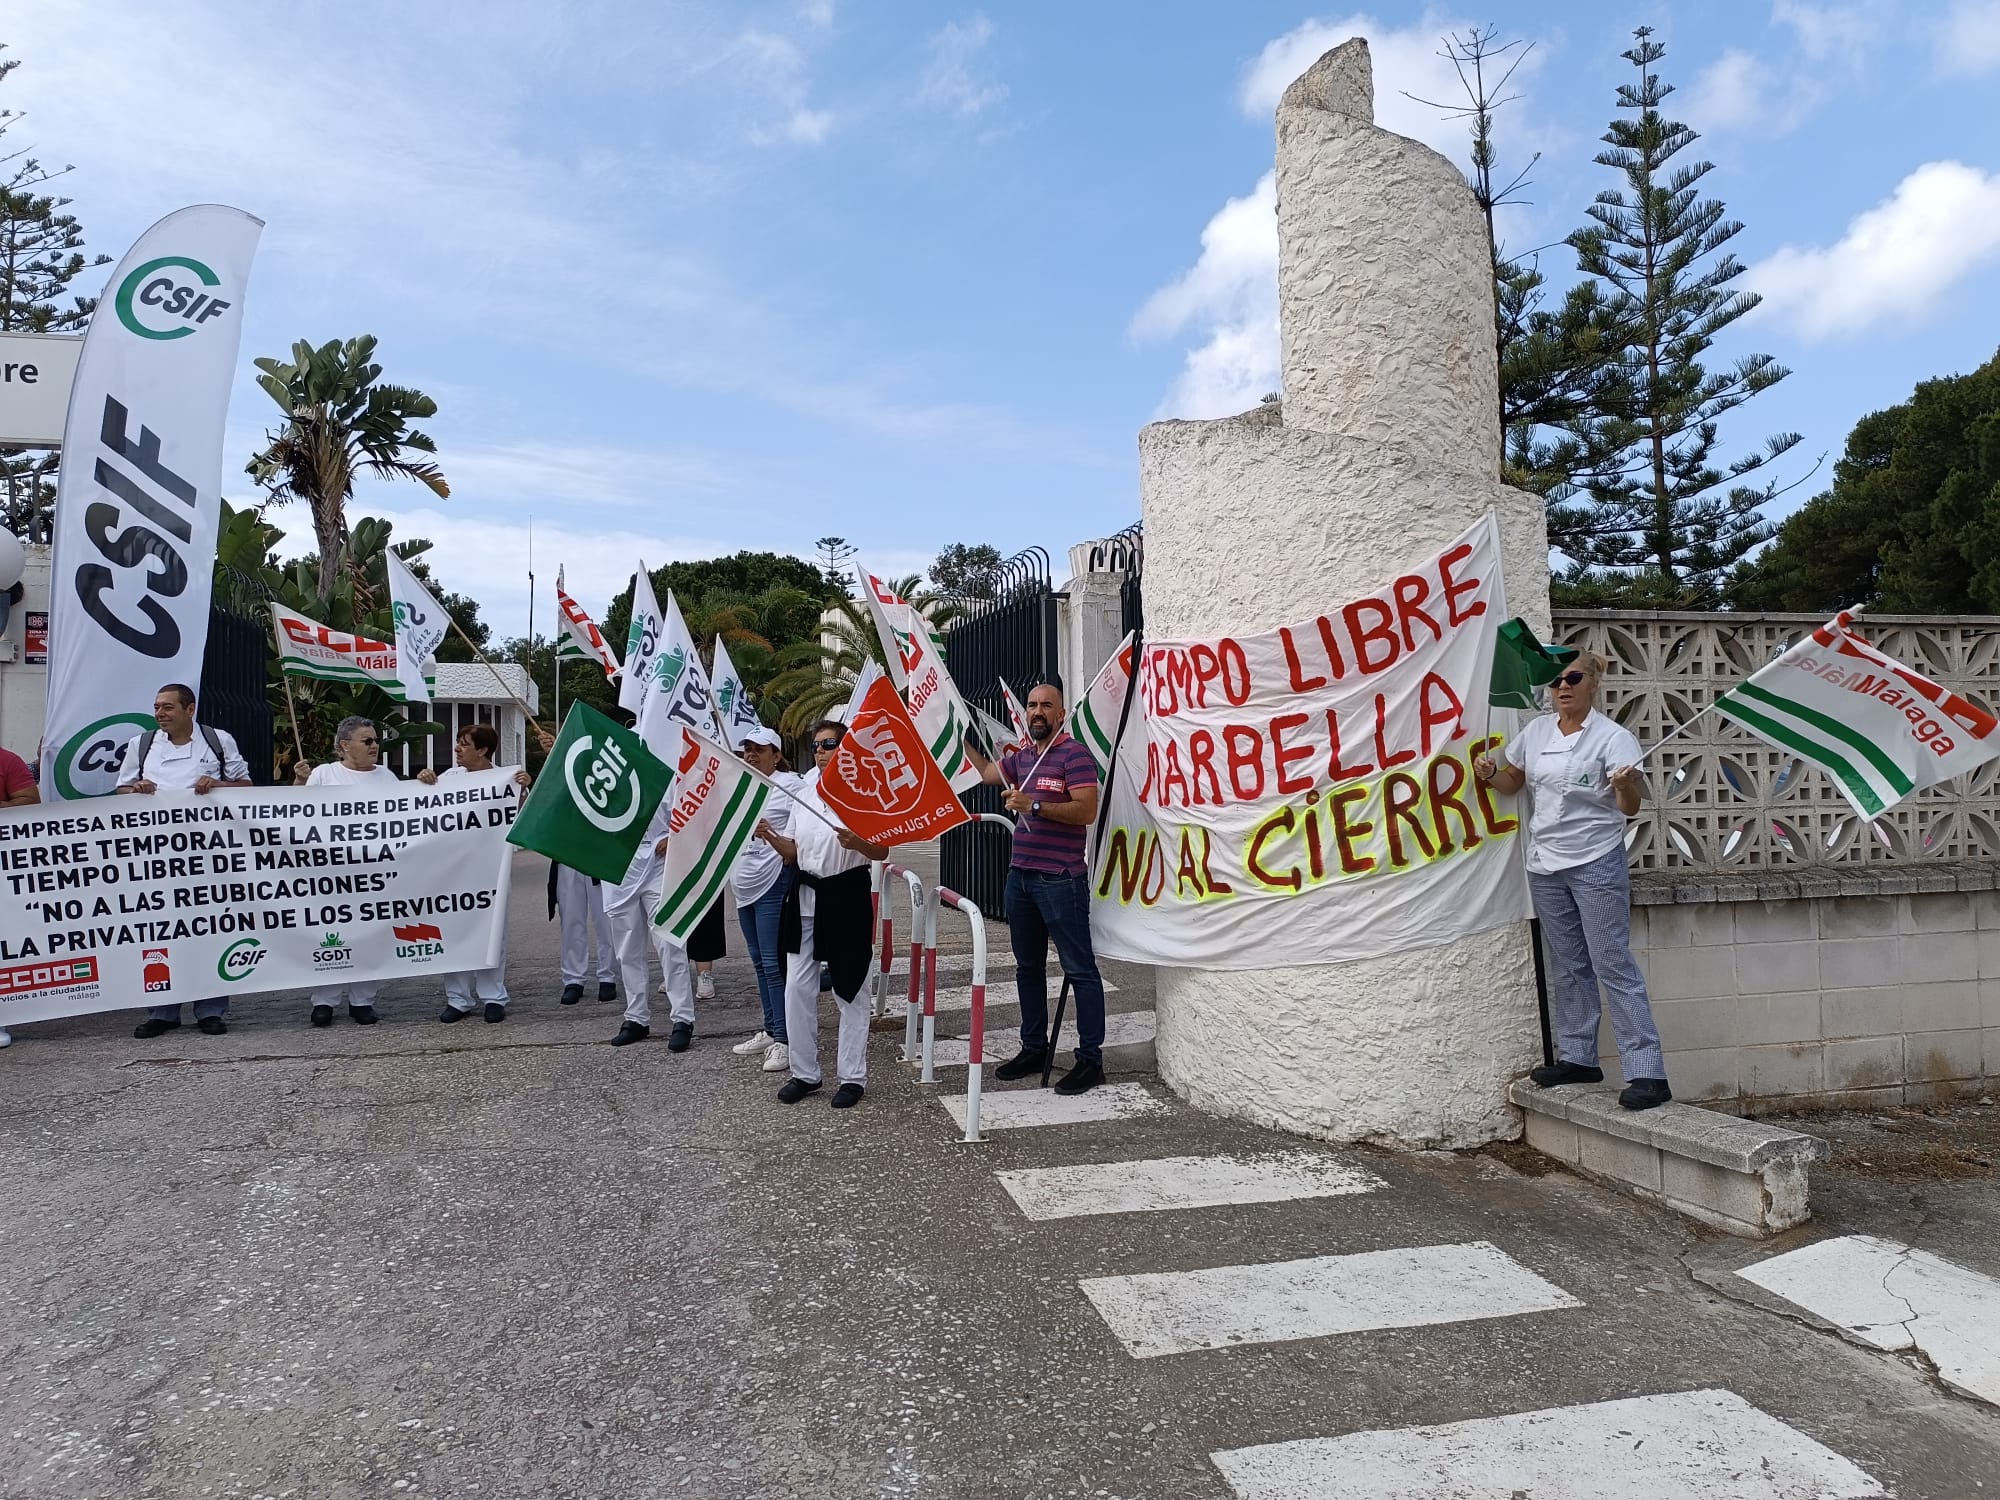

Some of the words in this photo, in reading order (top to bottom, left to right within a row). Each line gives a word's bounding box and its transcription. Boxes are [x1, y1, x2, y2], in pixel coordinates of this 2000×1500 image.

[140, 278, 230, 324] CSIF
[0, 364, 39, 384] re
[75, 394, 197, 658] CSIF
[1280, 544, 1486, 692] LIBRE
[356, 655, 397, 670] Mála
[1854, 674, 1955, 757] Málaga
[79, 740, 129, 773] CS
[854, 716, 919, 792] UGT
[1140, 672, 1467, 807] MARBELLA
[584, 736, 628, 809] CSIF
[668, 756, 721, 834] Málaga
[0, 817, 105, 841] EMPRESA
[110, 806, 234, 830] RESIDENCIA
[238, 803, 315, 820] TIEMPO
[321, 800, 379, 817] LIBRE
[384, 798, 408, 813] DE
[414, 784, 515, 811] MARBELLA
[95, 828, 243, 859] TEMPORAL
[249, 827, 282, 847] DE
[289, 825, 322, 845] LA
[330, 810, 482, 842] RESIDENCIA
[487, 806, 517, 827] DE
[867, 803, 954, 843] www.UGT.es
[7, 864, 120, 895] TIEMPO
[128, 856, 205, 882] LIBRE
[212, 852, 247, 874] DE
[1099, 829, 1164, 906] NO
[1178, 829, 1233, 897] AL
[92, 896, 112, 917] A
[119, 890, 165, 914] LAS
[1, 937, 40, 960] LA
[48, 907, 255, 953] PRIVATIZACIÓN
[263, 908, 297, 930] DE
[305, 904, 353, 926] LOS
[396, 942, 445, 959] USTEA
[227, 949, 267, 967] CSIF
[313, 948, 352, 963] SGDT
[39, 990, 48, 998] la
[145, 980, 169, 992] CGT
